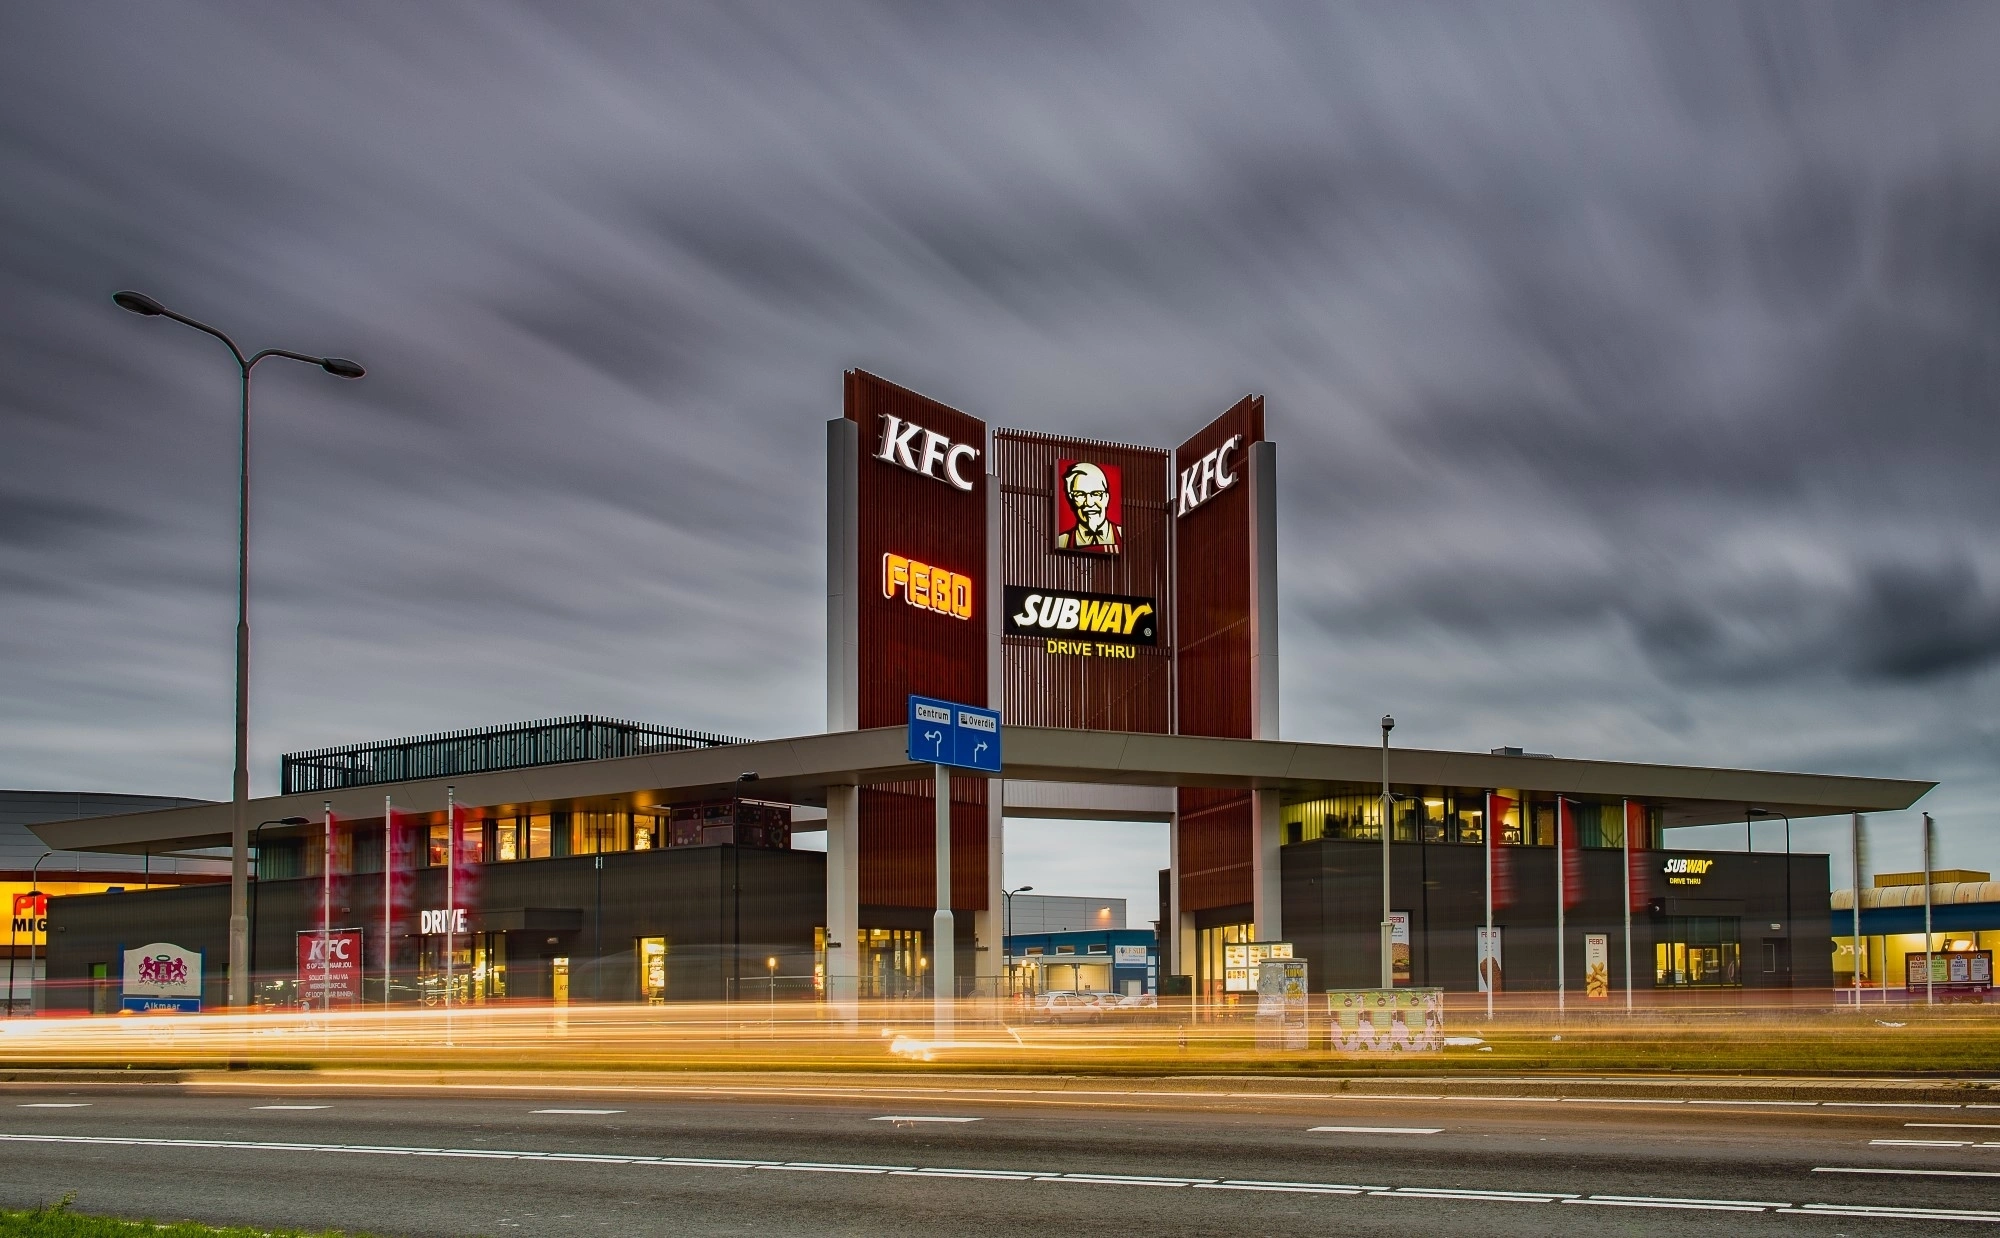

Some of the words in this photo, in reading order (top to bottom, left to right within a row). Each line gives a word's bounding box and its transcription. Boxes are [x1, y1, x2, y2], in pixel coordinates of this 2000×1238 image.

[876, 413, 977, 491] KFC
[1178, 435, 1238, 517] KFC
[883, 552, 971, 620] FEBO
[1013, 594, 1153, 635] SUBWAY
[1047, 640, 1092, 656] DRIVE
[1096, 643, 1135, 659] THRU
[917, 706, 949, 721] Centrum
[968, 715, 994, 729] Overdie
[1663, 859, 1713, 873] SUBWAY
[421, 909, 467, 934] DRIVE
[309, 939, 352, 960] KFC
[143, 1001, 181, 1010] Alkmaar
